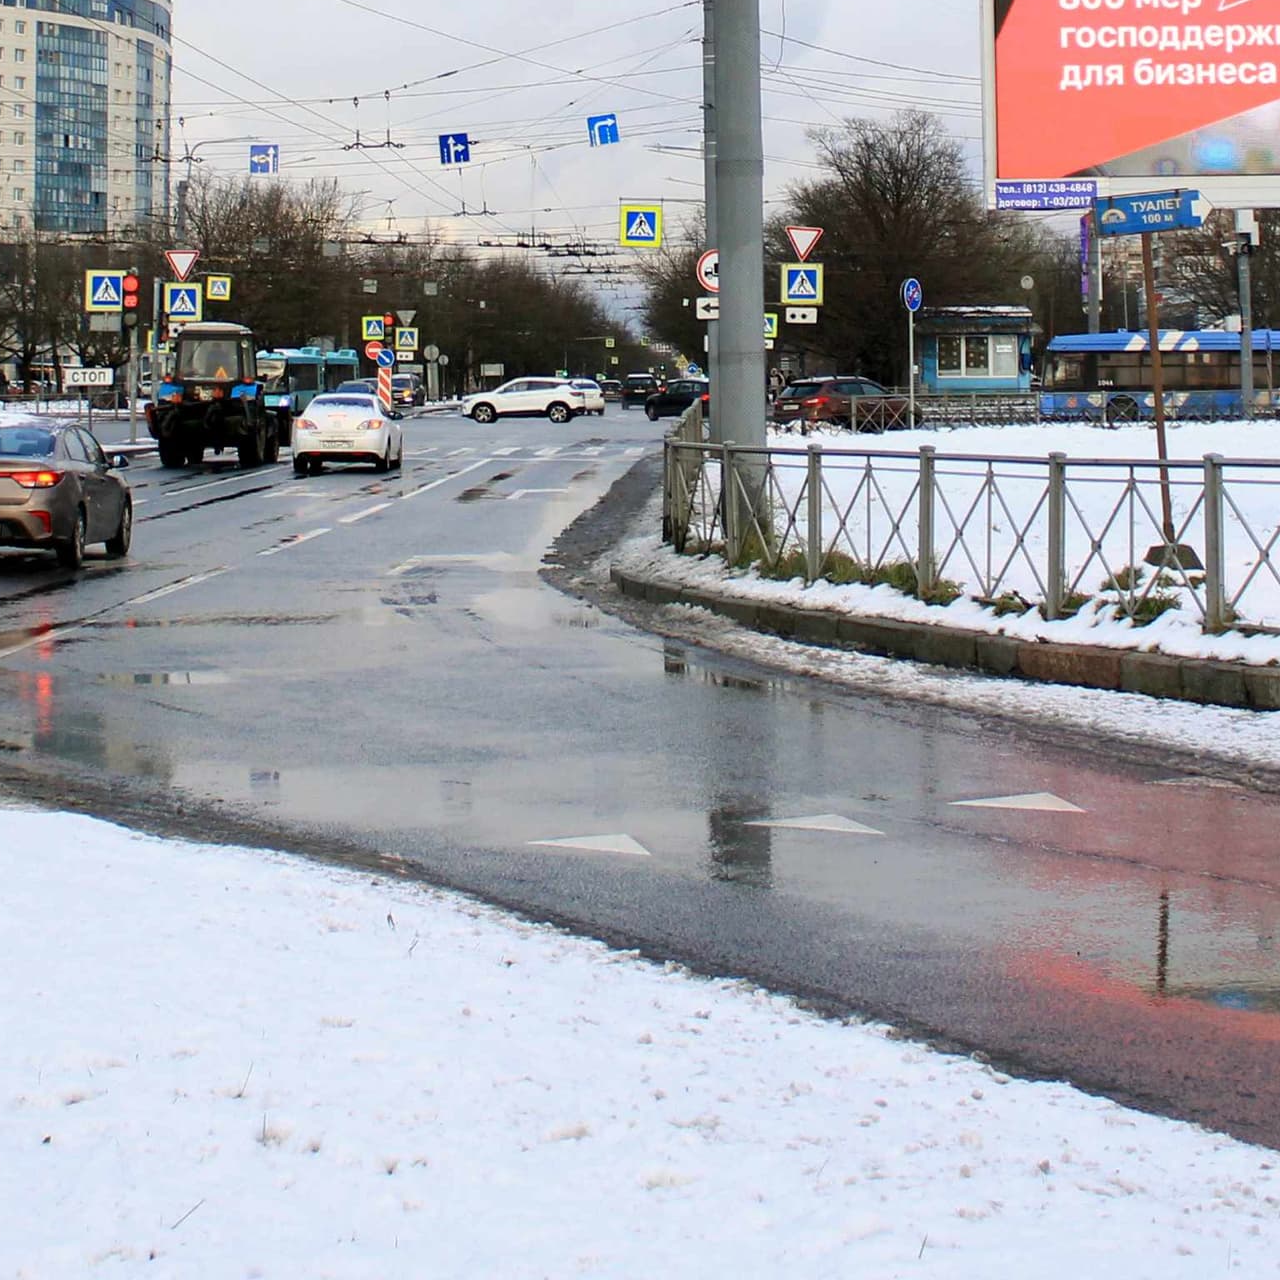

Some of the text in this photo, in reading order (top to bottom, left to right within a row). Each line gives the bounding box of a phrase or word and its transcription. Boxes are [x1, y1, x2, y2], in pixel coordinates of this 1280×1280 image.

[1059, 58, 1277, 91] для бизнеса
[1023, 183, 1046, 194] (812)
[998, 198, 1041, 209] договор:
[1130, 198, 1183, 214] ТУАЛЕТ
[1141, 213, 1174, 224] 100 м
[71, 371, 106, 383] СТОП
